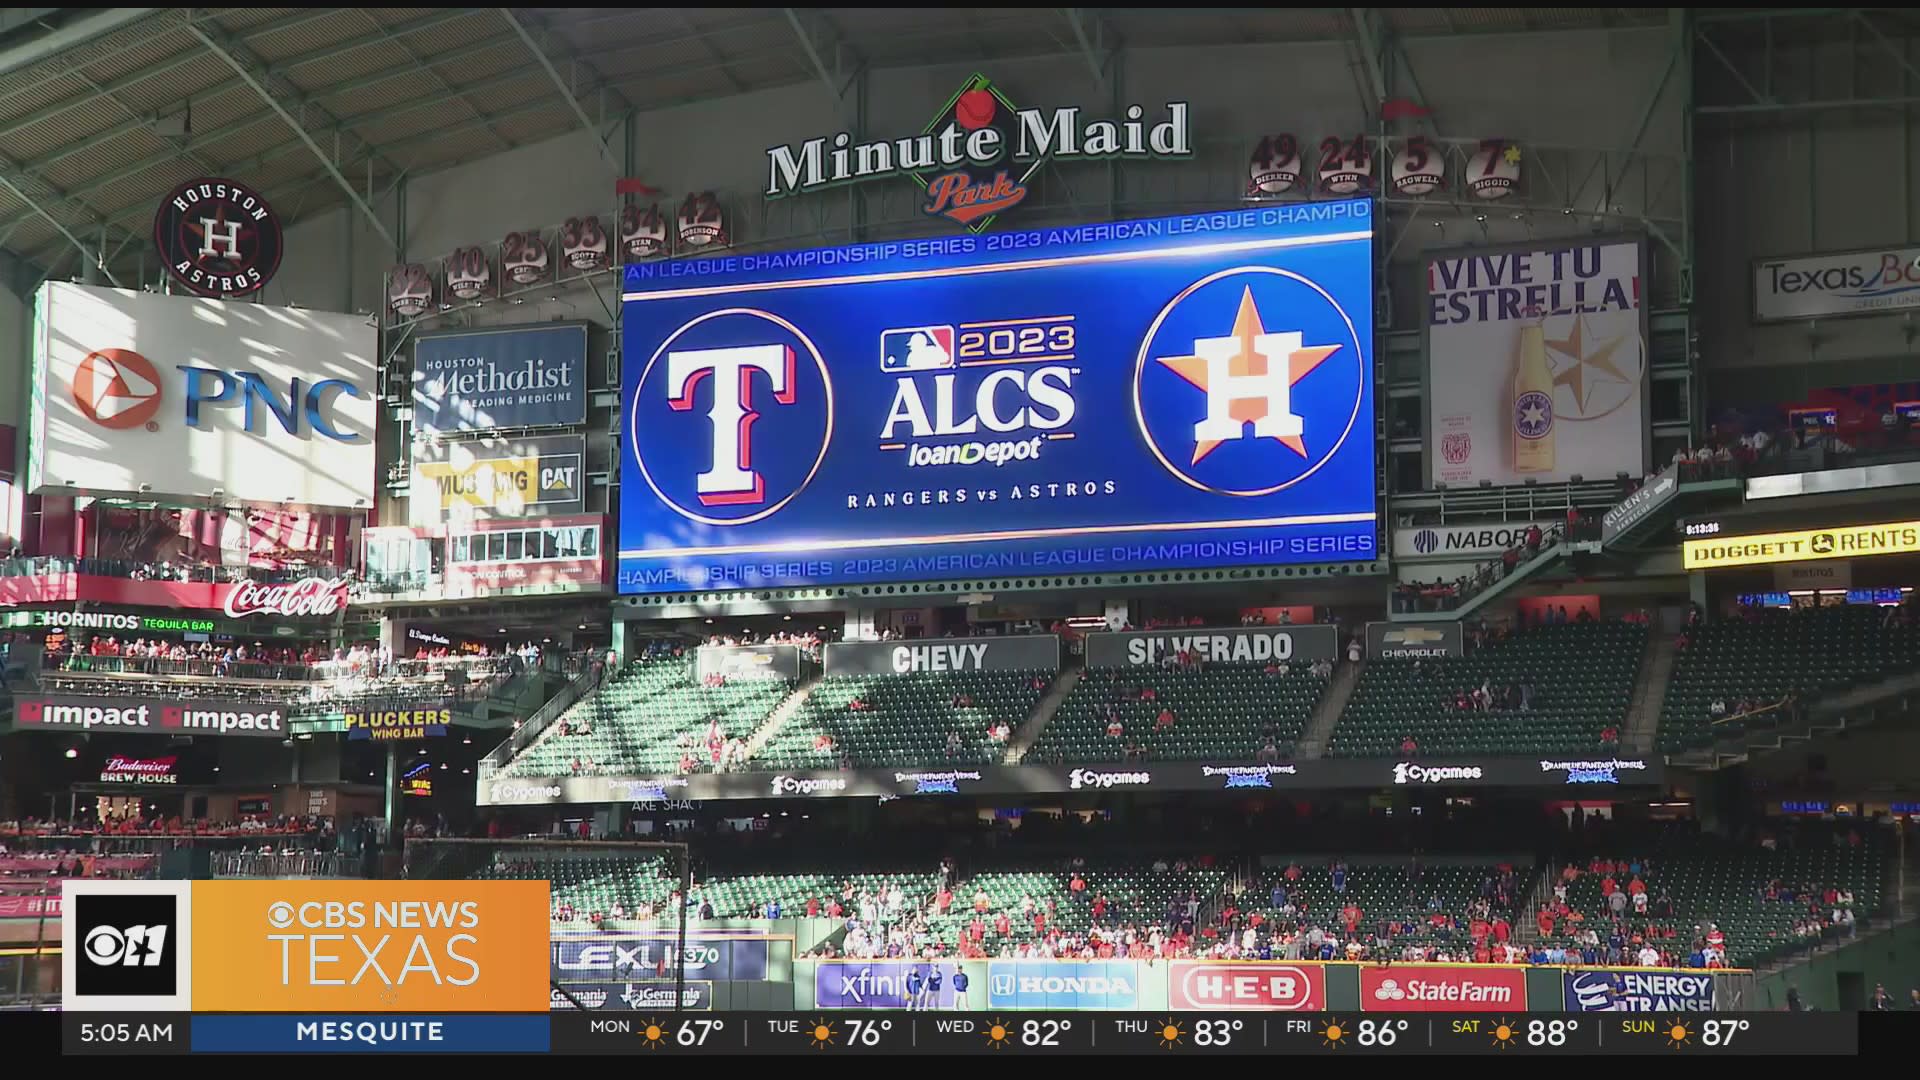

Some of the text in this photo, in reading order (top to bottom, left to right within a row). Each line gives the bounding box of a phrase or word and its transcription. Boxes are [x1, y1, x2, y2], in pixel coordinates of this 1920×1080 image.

[766, 102, 1191, 195] Minute Maid
[1251, 133, 1297, 170] 49
[1320, 134, 1368, 172] 24
[1405, 135, 1429, 173] 5
[1479, 139, 1504, 177] 7
[926, 170, 1027, 214] Park
[1256, 172, 1294, 185] DIERKER
[1330, 174, 1358, 184] WYNN
[1396, 176, 1439, 188] BAGWELL
[1475, 178, 1510, 189] BIGGIO
[172, 184, 269, 222] HOUSTON
[563, 216, 601, 249] 33
[625, 200, 1369, 281] AN LEAGUE CHAMPIONSHIP SERIES 2023 AMERICAN LEAGUE CHAMPIO
[630, 238, 652, 247] RYAN
[504, 231, 547, 264] 25
[570, 252, 596, 260] SCOTT
[175, 260, 261, 292] ASTROS
[1551, 247, 1601, 281] TU
[452, 281, 481, 291] WILSN
[1764, 263, 1865, 295] Texas
[1428, 276, 1641, 326] ESTRELLA!
[960, 326, 1075, 357] 2023
[426, 357, 485, 371] HOUSTON
[433, 359, 572, 396] Methodist
[176, 365, 361, 441] PNC
[519, 392, 572, 405] MEDICINE
[880, 366, 1076, 439] ALCS
[908, 436, 1041, 467] loanDepot
[541, 466, 575, 490] CAT
[848, 489, 967, 509] RANGERS
[1011, 480, 1116, 499] ASTROS
[1604, 489, 1651, 528] KILLEN'S
[761, 561, 833, 579] SERIES
[844, 558, 898, 575] 2023
[903, 552, 1014, 572] AMERICAN
[1028, 550, 1105, 568] LEAGUE
[1112, 539, 1284, 562] CHAMPIONSHIP
[1290, 535, 1373, 553] SERIES
[1694, 528, 1917, 561] DOGGETT RENTS
[43, 611, 214, 632] HORNITOS TEQUILA BAR
[892, 644, 988, 673] CHEVY
[1382, 648, 1448, 659] CHEVROLET
[43, 702, 150, 728] impact
[183, 706, 281, 733] impact
[345, 709, 451, 729] PLUCKERS
[371, 727, 425, 739] WING BAR
[100, 772, 177, 784] BREW HOUSE
[106, 759, 171, 773] Budweiser
[1083, 769, 1150, 788] Cygames
[1408, 765, 1482, 783] Cygames
[503, 785, 561, 800] Cygames
[784, 777, 846, 793] Cygames
[643, 987, 700, 1001] Germnia
[1019, 976, 1133, 994] HONDA
[1624, 974, 1710, 997] ENERGY
